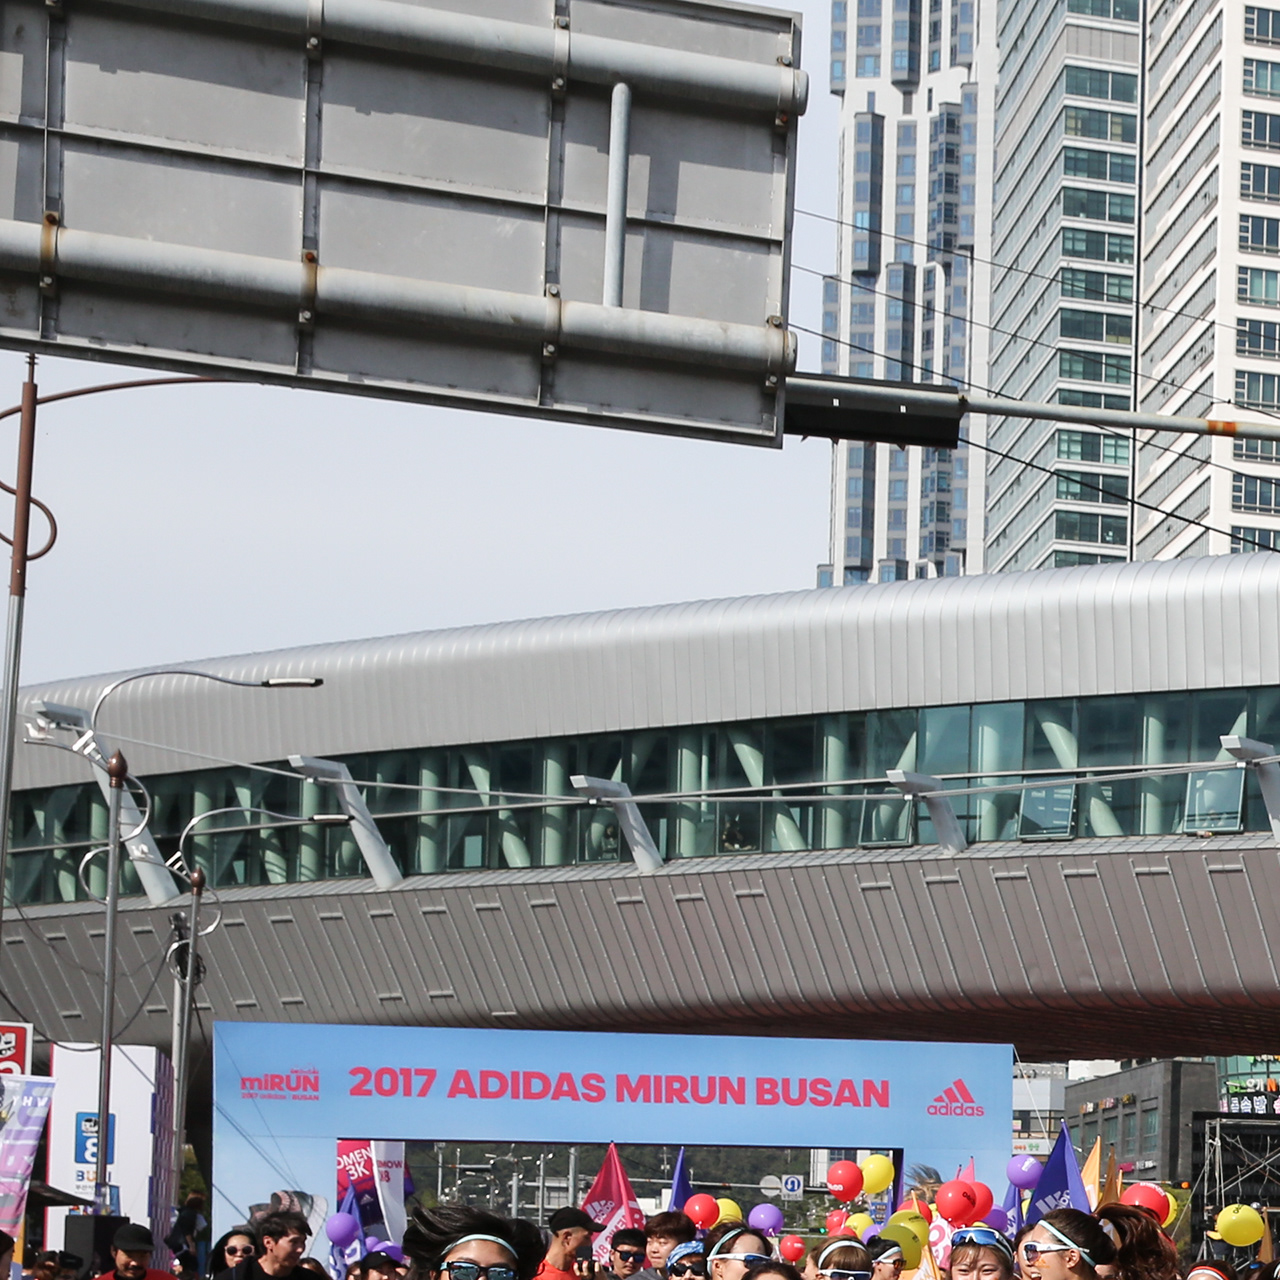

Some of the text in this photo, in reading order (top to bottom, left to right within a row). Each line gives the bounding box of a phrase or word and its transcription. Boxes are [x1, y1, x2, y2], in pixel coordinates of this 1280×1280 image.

[348, 1066, 890, 1109] 2017 ADIDAS MIRUN BUSAN
[926, 1102, 985, 1118] adidas
[345, 1160, 370, 1180] 3K
